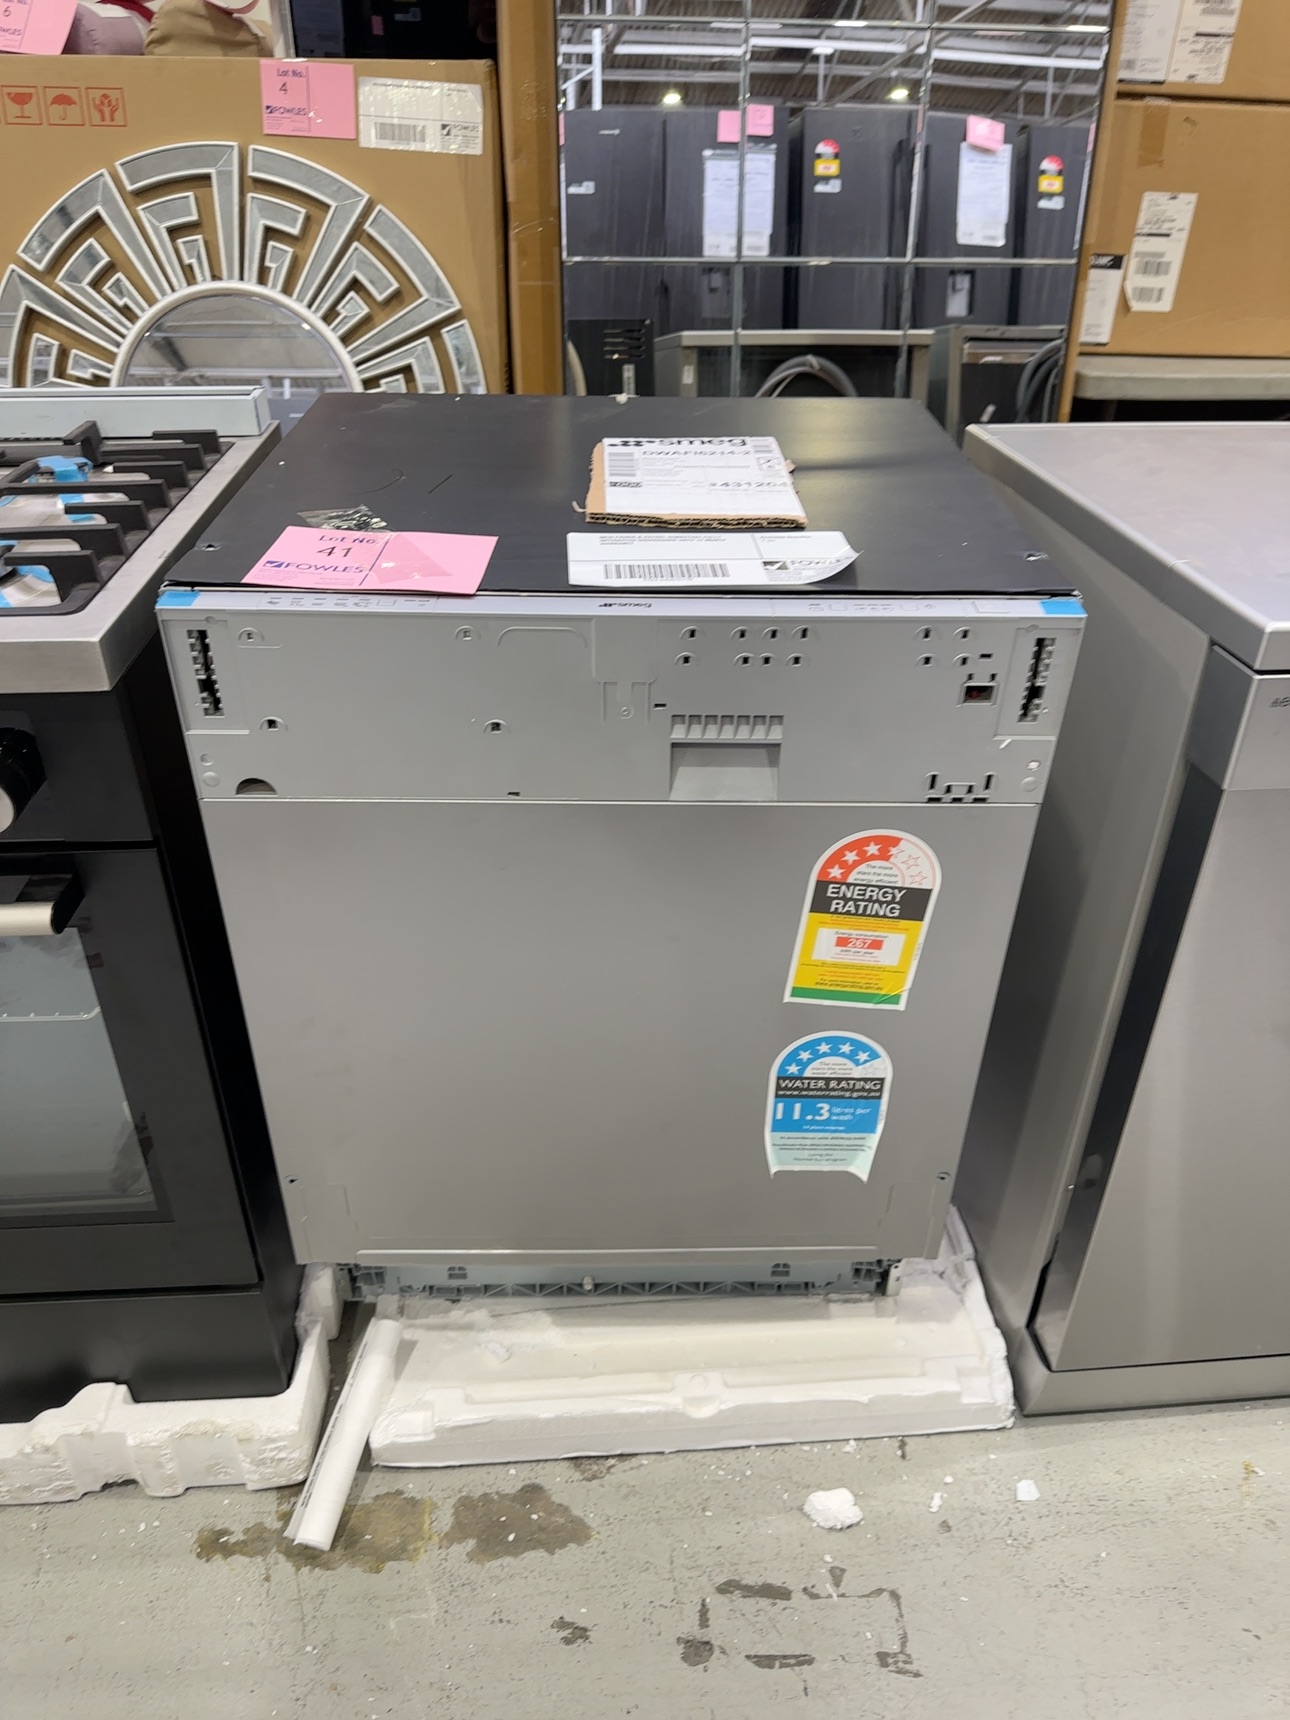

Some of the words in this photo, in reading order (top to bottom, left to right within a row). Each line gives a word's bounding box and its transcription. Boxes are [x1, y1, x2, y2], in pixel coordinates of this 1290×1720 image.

[3, 6, 12, 17] 6
[277, 68, 289, 77] Lot
[279, 81, 288, 95] 4
[272, 106, 307, 116] FOWLES
[658, 438, 747, 447] smeg
[319, 535, 345, 543] Lot
[316, 546, 353, 558] 41
[283, 563, 366, 574] FOWLES
[826, 884, 907, 901] ENERGY
[829, 899, 901, 917] RATING
[846, 938, 872, 948] 267
[778, 1080, 826, 1089] WATER
[828, 1080, 881, 1090] RATING
[775, 1102, 831, 1120] 11.3
